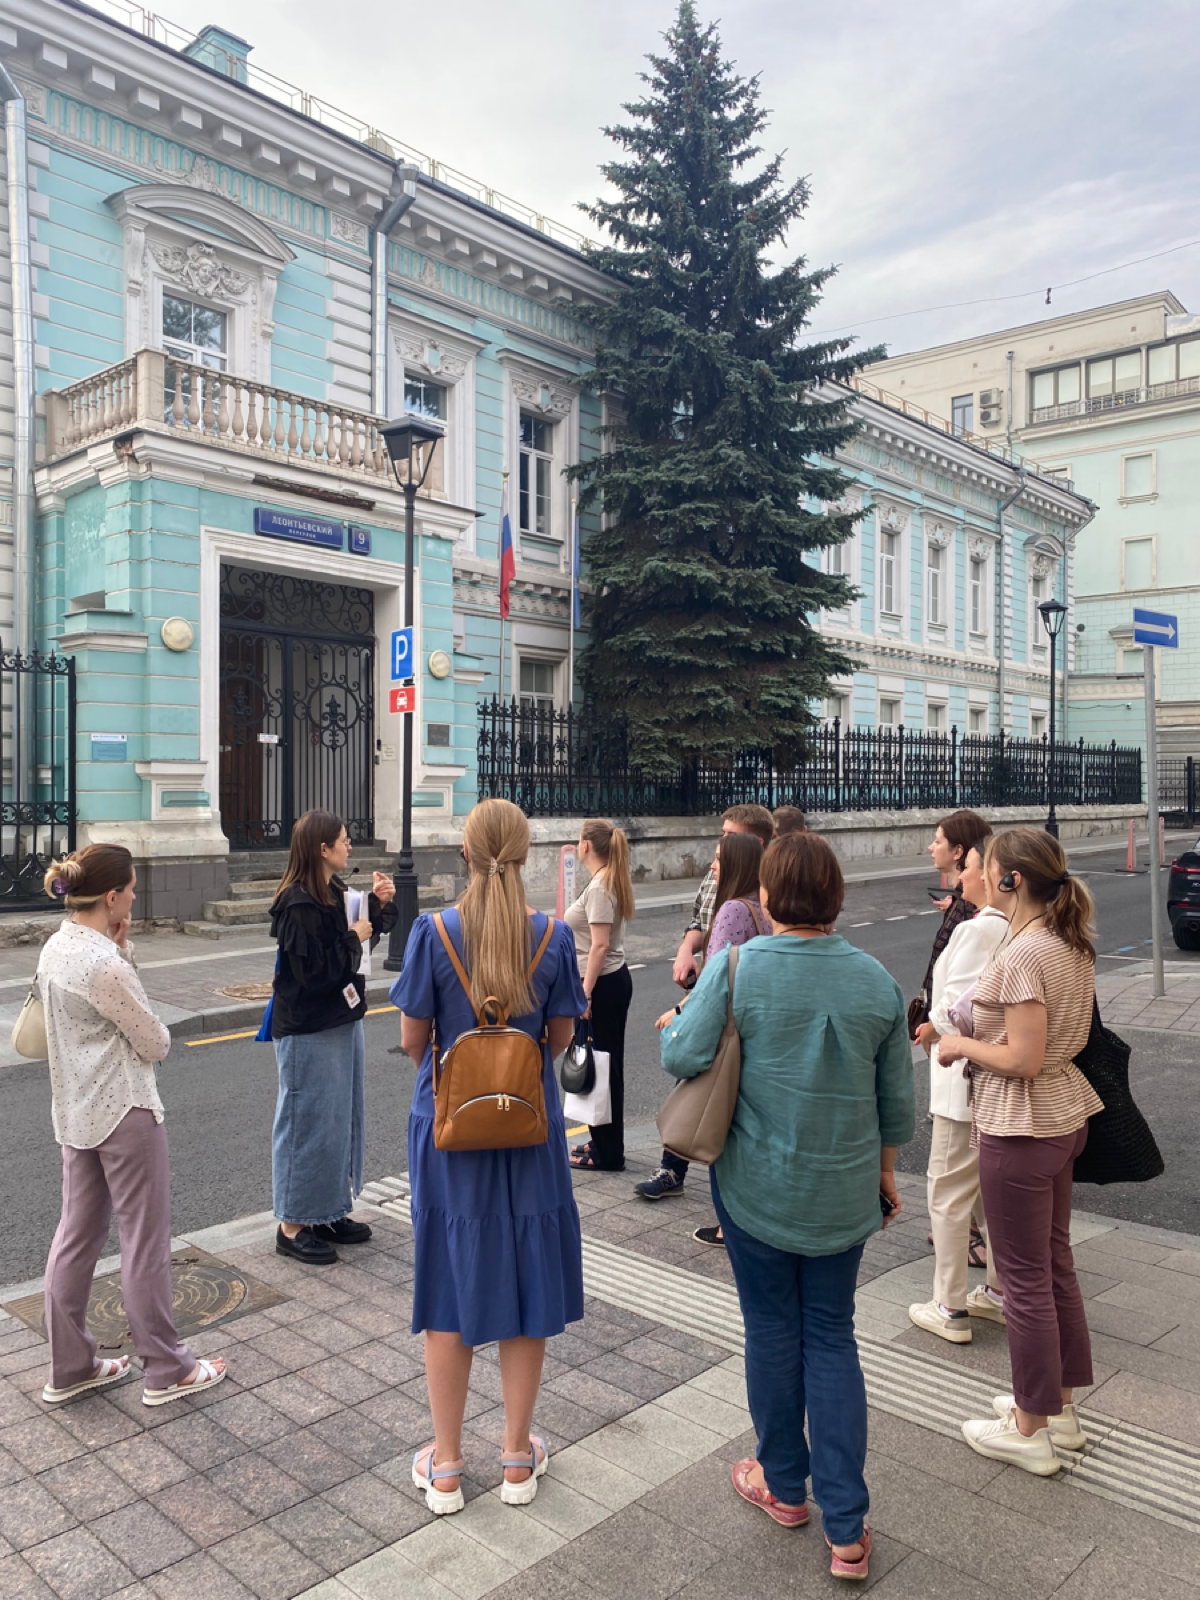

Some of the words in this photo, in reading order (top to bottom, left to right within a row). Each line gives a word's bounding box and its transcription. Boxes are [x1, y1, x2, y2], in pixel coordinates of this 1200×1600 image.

[272, 515, 333, 536] ЛЕОНТЬЕВСКИЙ
[358, 532, 365, 545] 9
[395, 634, 409, 675] P
